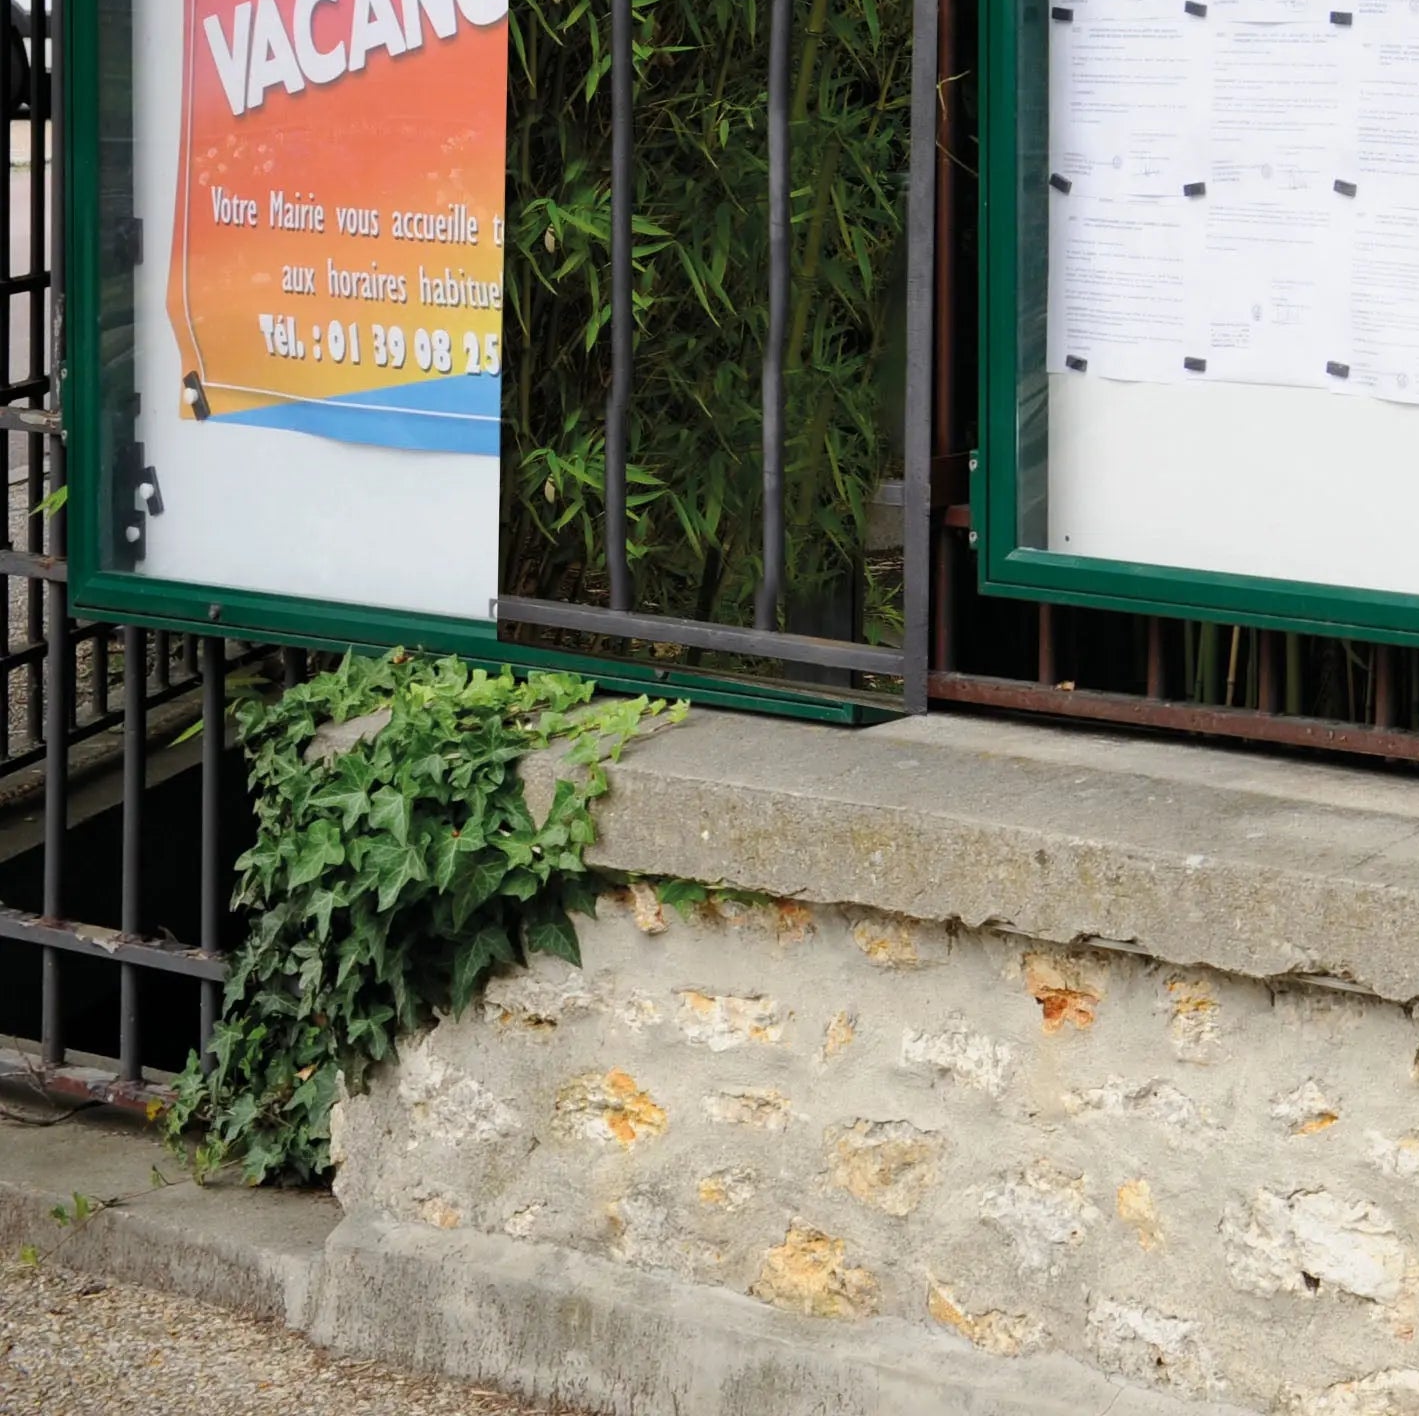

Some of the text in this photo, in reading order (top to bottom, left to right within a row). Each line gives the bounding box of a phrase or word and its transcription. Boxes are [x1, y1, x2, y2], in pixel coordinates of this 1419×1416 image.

[211, 186, 257, 227] Votre
[269, 189, 325, 232] Mairie
[336, 206, 379, 238] vous
[392, 202, 478, 244] accueille
[282, 264, 315, 295] aux
[327, 258, 407, 303] horaires
[259, 313, 304, 359] Tél.
[328, 320, 360, 364] 01
[372, 324, 406, 368] 39
[414, 328, 452, 374] 08
[463, 331, 500, 376] 25
